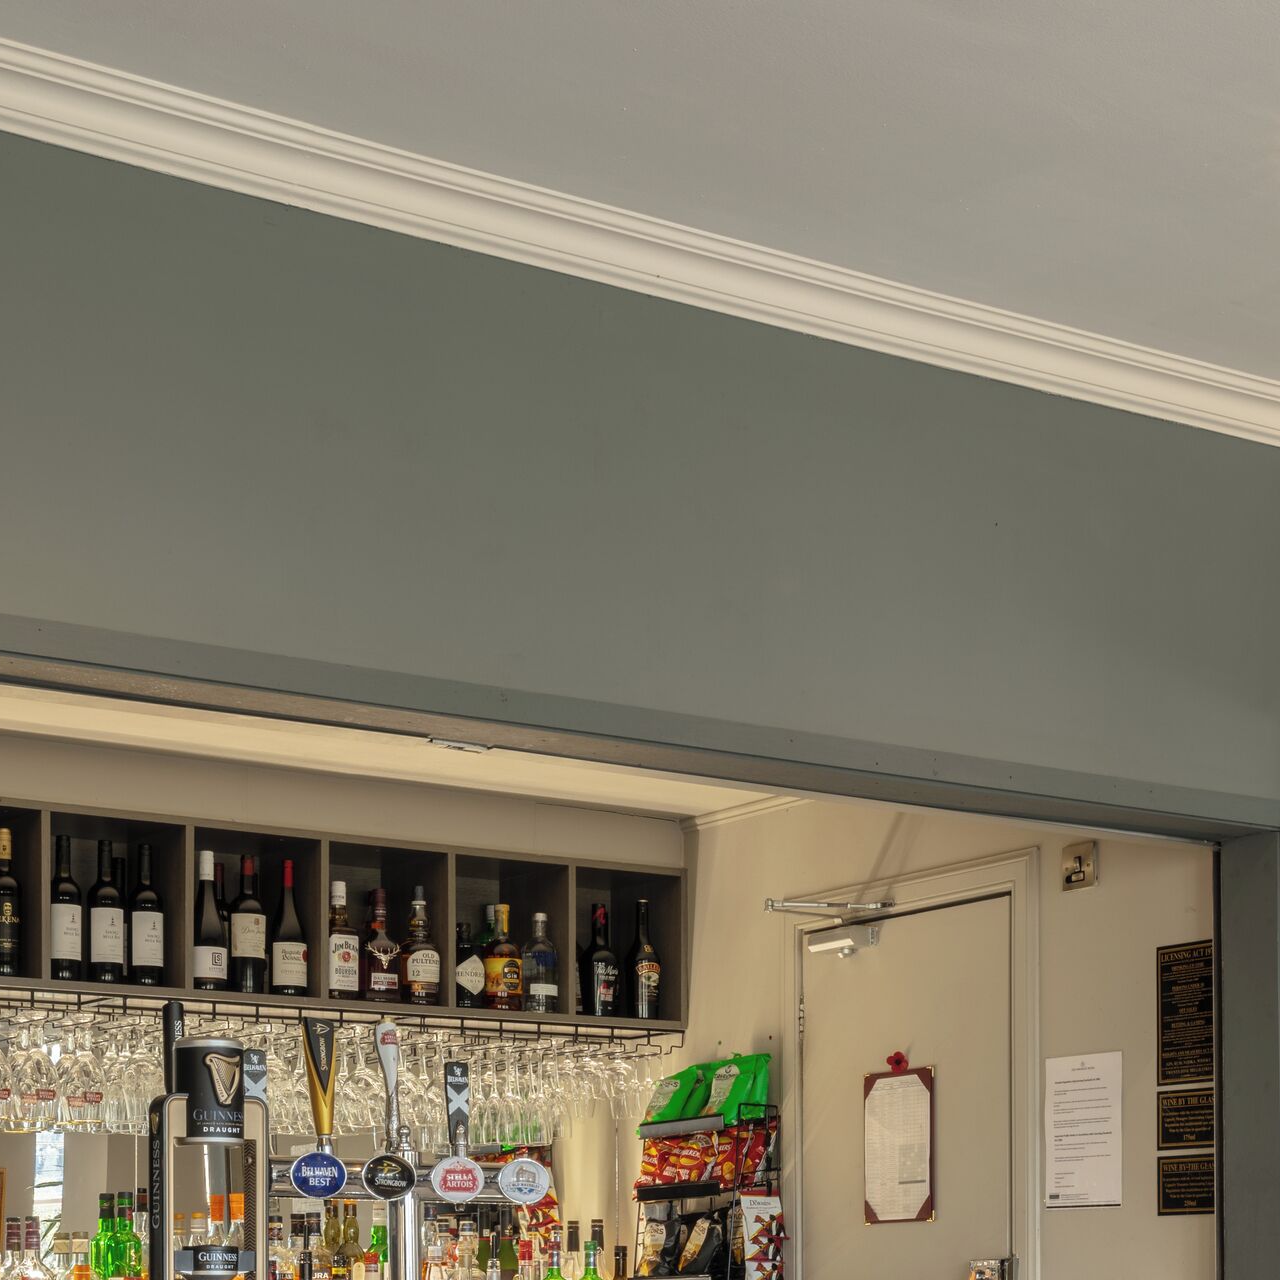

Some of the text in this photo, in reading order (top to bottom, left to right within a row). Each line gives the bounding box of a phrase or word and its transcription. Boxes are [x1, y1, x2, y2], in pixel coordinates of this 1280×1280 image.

[332, 943, 345, 954] JIM
[334, 967, 357, 976] BOURBON
[447, 1075, 469, 1084] BELHAVEN
[1162, 1098, 1178, 1106] WINE
[203, 1126, 241, 1134] DRAUGHT
[301, 1165, 338, 1178] BELHAVEN
[1162, 1163, 1178, 1171] WINE
[446, 1172, 473, 1181] STELLA
[151, 1139, 161, 1230] GUINNESS
[308, 1177, 332, 1187] BEST
[374, 1177, 408, 1188] STRONGBOW
[446, 1180, 474, 1189] ARTOIS
[198, 1251, 238, 1262] GUINNESS
